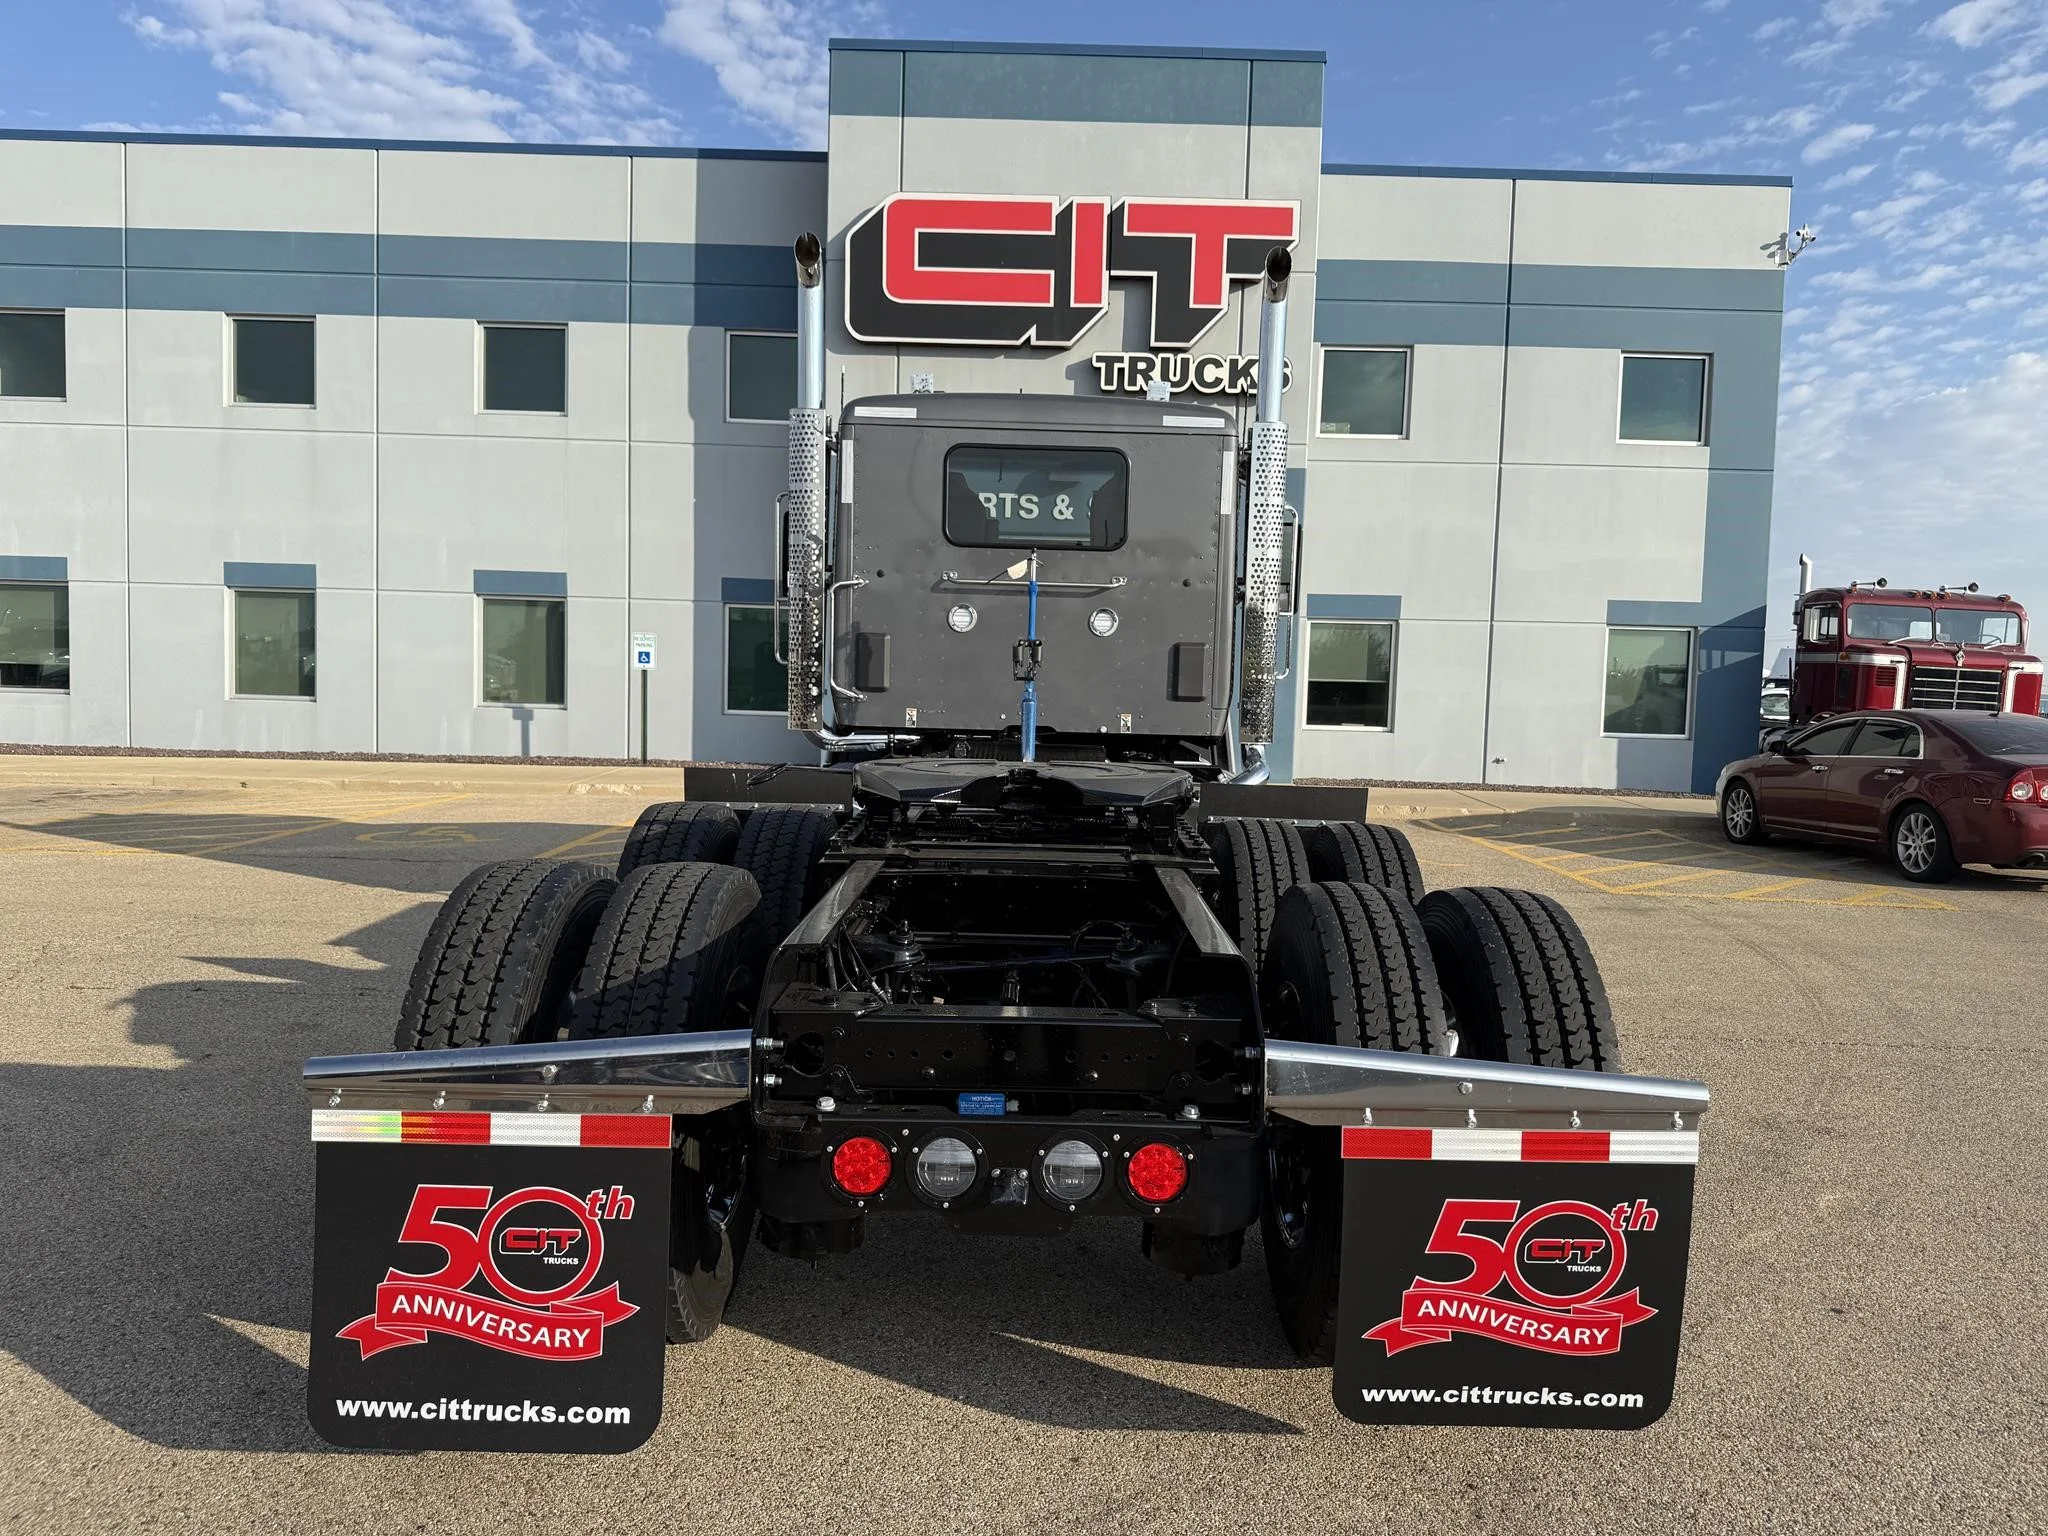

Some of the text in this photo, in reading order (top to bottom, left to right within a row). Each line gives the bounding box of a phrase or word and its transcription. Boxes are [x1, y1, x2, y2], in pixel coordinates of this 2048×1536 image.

[846, 193, 1301, 348] CIT
[1052, 494, 1074, 520] &
[500, 1228, 581, 1254] CIT
[1524, 1238, 1605, 1263] CIT
[543, 1257, 579, 1265] TRUCKS
[391, 1294, 591, 1348] ANNIVERSARY
[1417, 1299, 1610, 1345] ANNIVERSARY
[1361, 1386, 1644, 1408] www.cittrucks.com
[336, 1398, 631, 1424] www.cittrucks.com
